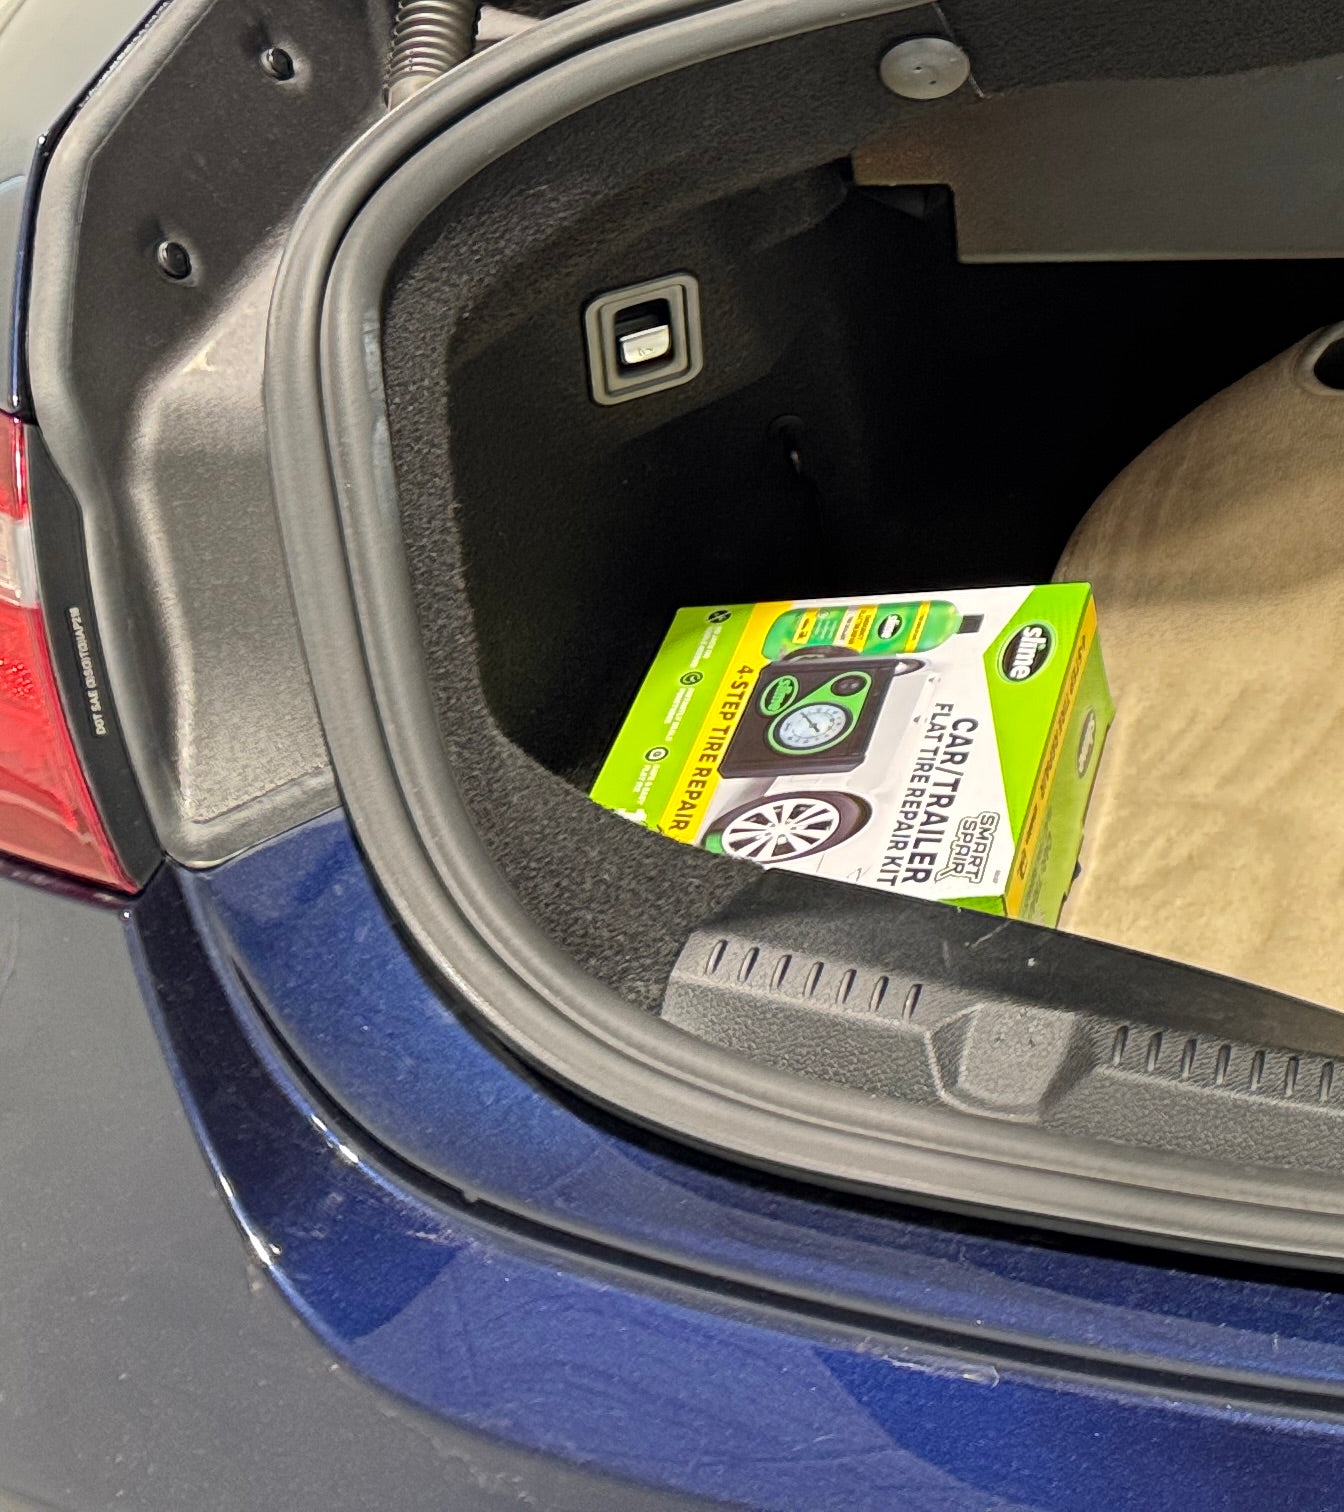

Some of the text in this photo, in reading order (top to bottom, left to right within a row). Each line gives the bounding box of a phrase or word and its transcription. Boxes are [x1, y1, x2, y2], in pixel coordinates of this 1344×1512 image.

[1009, 626, 1047, 679] slime
[87, 690, 106, 735] DOT SAE
[718, 665, 754, 721] 4-STEP
[698, 725, 731, 763] TIRE
[668, 767, 712, 831] REPAIR
[877, 703, 954, 886] FLAT TIRE REPAIR KIT
[901, 718, 979, 884] CAR/TRAILER
[940, 820, 977, 877] SPAIR
[965, 814, 995, 880] SMART
